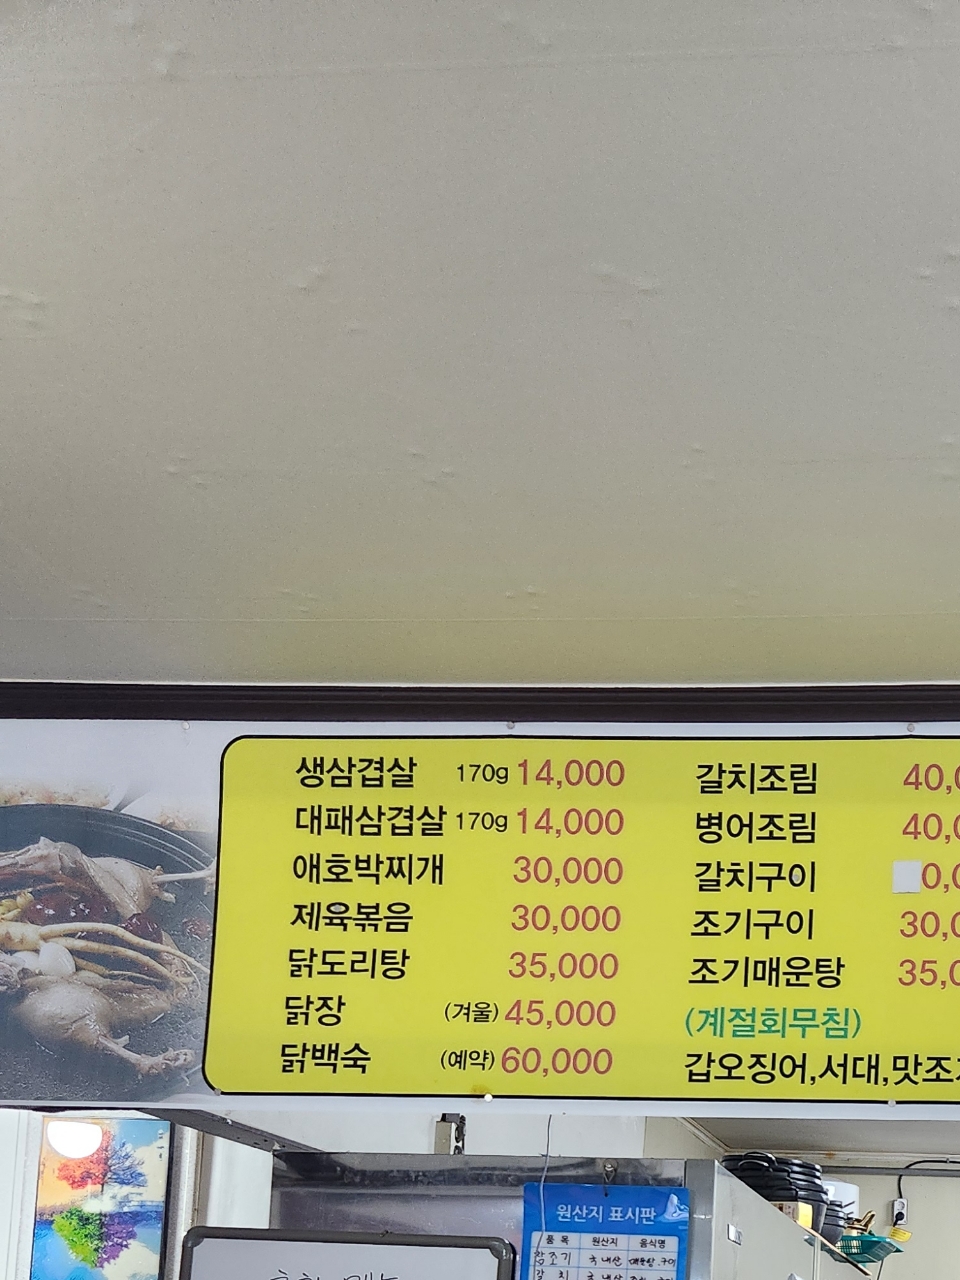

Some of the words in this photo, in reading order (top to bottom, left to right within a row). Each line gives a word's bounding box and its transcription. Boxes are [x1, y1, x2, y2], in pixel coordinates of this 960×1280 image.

[295, 756, 417, 789] 생삼겹살
[457, 764, 509, 784] 170g
[517, 759, 625, 789] 14,000
[696, 763, 818, 795] 갈치조림
[295, 804, 447, 837] 대패삼겹살
[455, 812, 509, 832] 170g
[517, 808, 624, 837] 14,000
[696, 811, 816, 844] 병어조림
[292, 853, 445, 885] 애호박찌개
[513, 857, 624, 886] 30,000
[694, 860, 816, 893] 갈치구이
[290, 902, 413, 933] 제육볶음
[511, 905, 621, 934] 30,000
[690, 908, 814, 940] 조기구이
[288, 948, 410, 980] 닭도리탕
[508, 952, 619, 982] 35,000
[688, 956, 845, 989] 조기매운탕
[284, 995, 346, 1027] 닭장
[444, 1002, 499, 1023] (겨울)
[504, 999, 616, 1029] 45,000
[685, 1007, 862, 1039] (계절회무침)
[281, 1042, 371, 1074] 닭백숙
[440, 1049, 495, 1072] (예약)
[502, 1047, 613, 1077] 60,000
[556, 1204, 603, 1223] 원산지
[608, 1207, 656, 1225] 표시판
[592, 1236, 618, 1247] 원산지
[639, 1238, 666, 1249] 음식명
